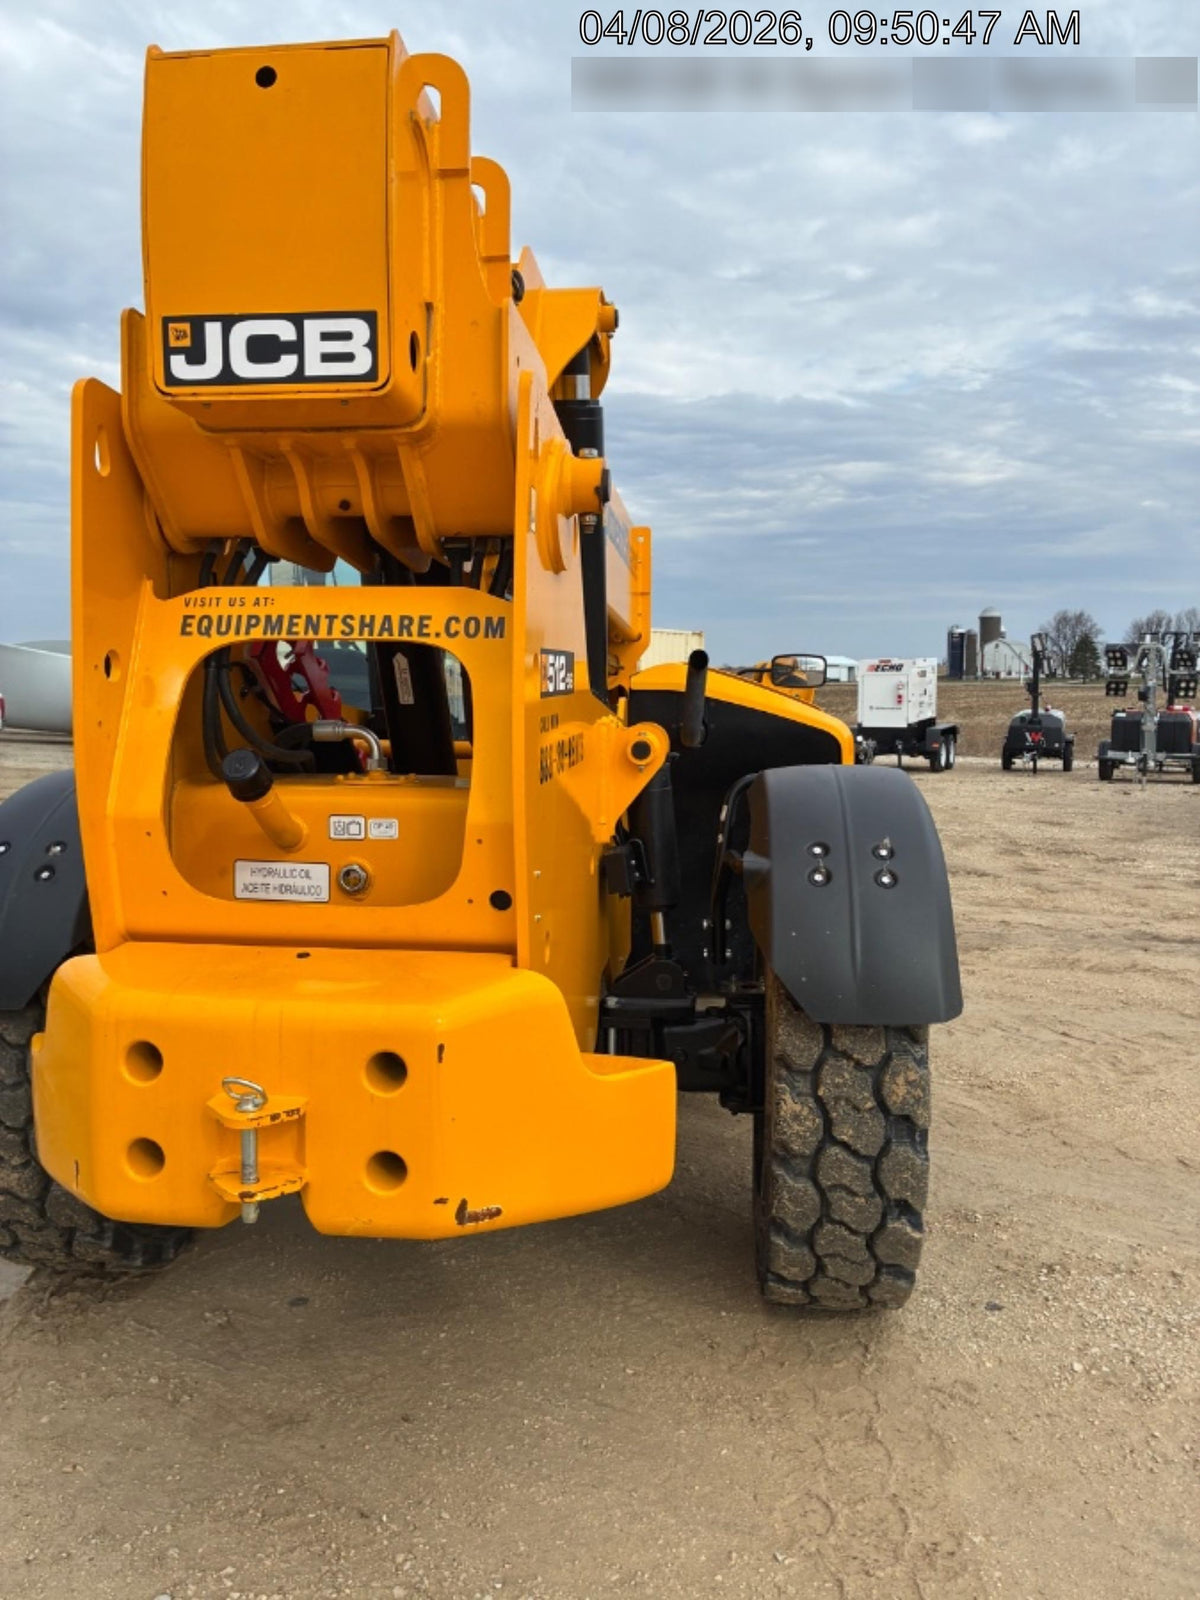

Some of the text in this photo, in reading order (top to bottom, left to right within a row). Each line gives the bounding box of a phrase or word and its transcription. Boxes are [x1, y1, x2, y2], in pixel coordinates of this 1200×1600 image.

[169, 317, 373, 381] JCB
[183, 597, 275, 608] VISIT US AT:
[180, 614, 506, 640] EQUIPMENTSHARE.COM
[547, 653, 566, 693] 512
[250, 867, 312, 880] HYDRAULIC OIL
[241, 882, 271, 895] ACEITE
